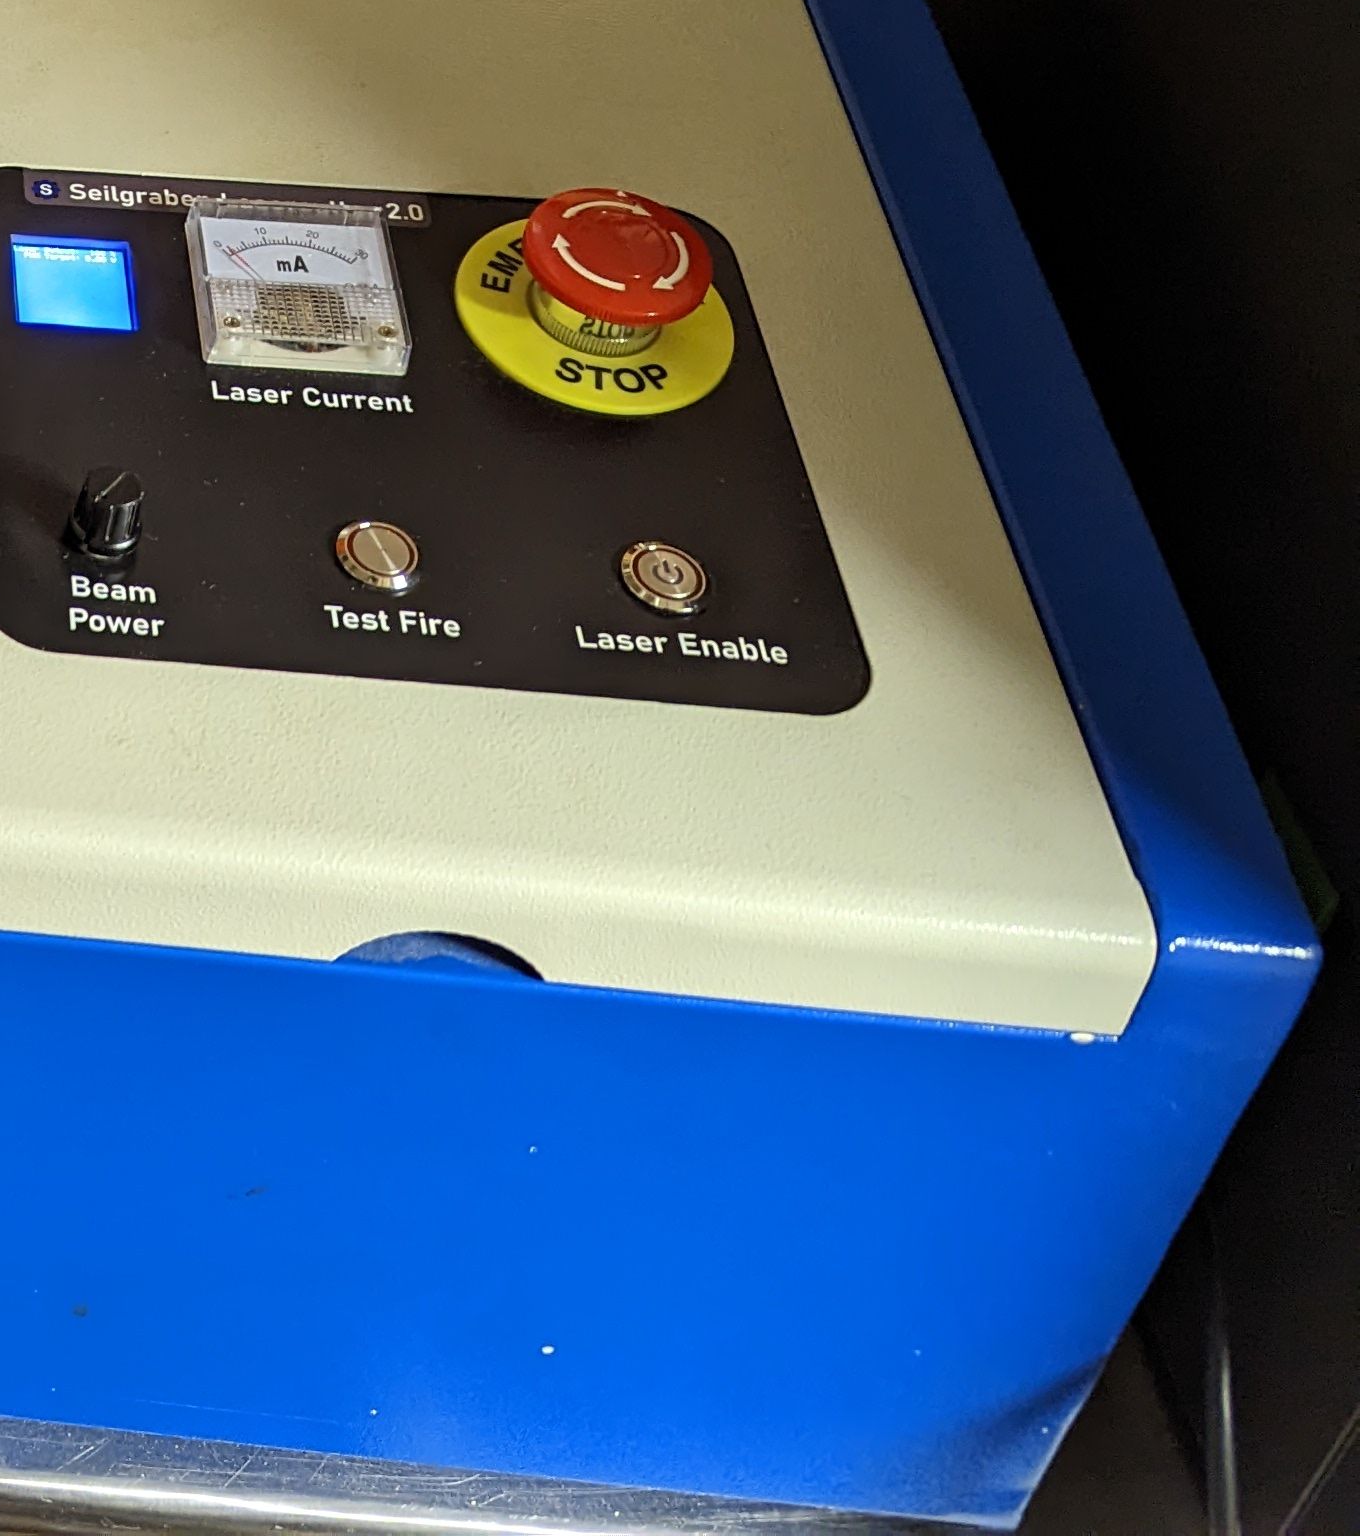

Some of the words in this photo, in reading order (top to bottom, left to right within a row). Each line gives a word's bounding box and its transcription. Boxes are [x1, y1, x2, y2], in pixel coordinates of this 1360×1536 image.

[69, 183, 208, 207] Seilgrabe
[385, 202, 424, 221] 2.0
[254, 226, 267, 236] 10
[305, 229, 319, 240] 20
[354, 248, 369, 261] 30
[276, 255, 309, 274] mA
[555, 357, 668, 394] STOP
[210, 379, 294, 405] Laser
[302, 387, 414, 413] Current
[70, 574, 157, 604] Beam
[68, 607, 165, 637] Power
[323, 604, 391, 632] Test
[398, 610, 461, 638] Fire
[575, 625, 669, 654] Laser
[677, 632, 788, 665] Enable
